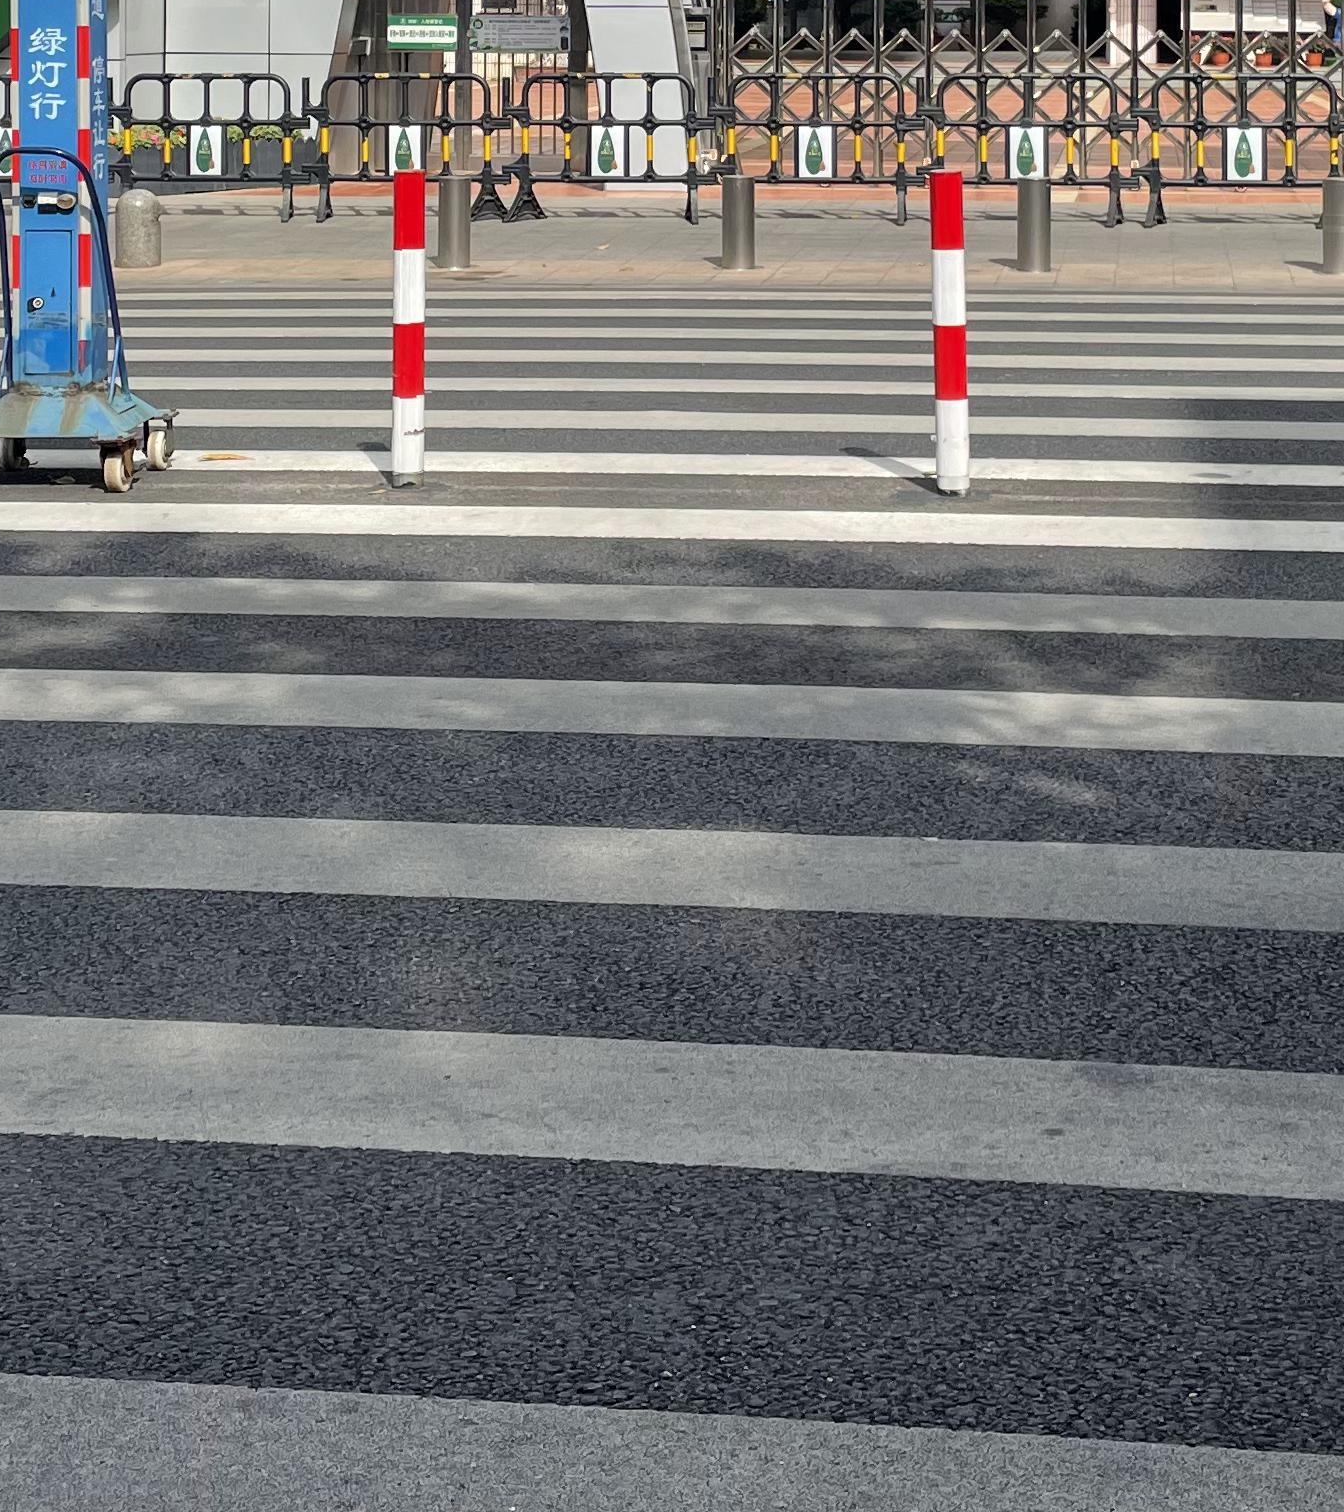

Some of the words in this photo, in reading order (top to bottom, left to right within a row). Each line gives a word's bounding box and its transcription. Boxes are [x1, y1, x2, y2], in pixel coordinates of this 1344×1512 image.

[27, 26, 69, 121] 绿灯行
[90, 55, 106, 182] 停车让行
